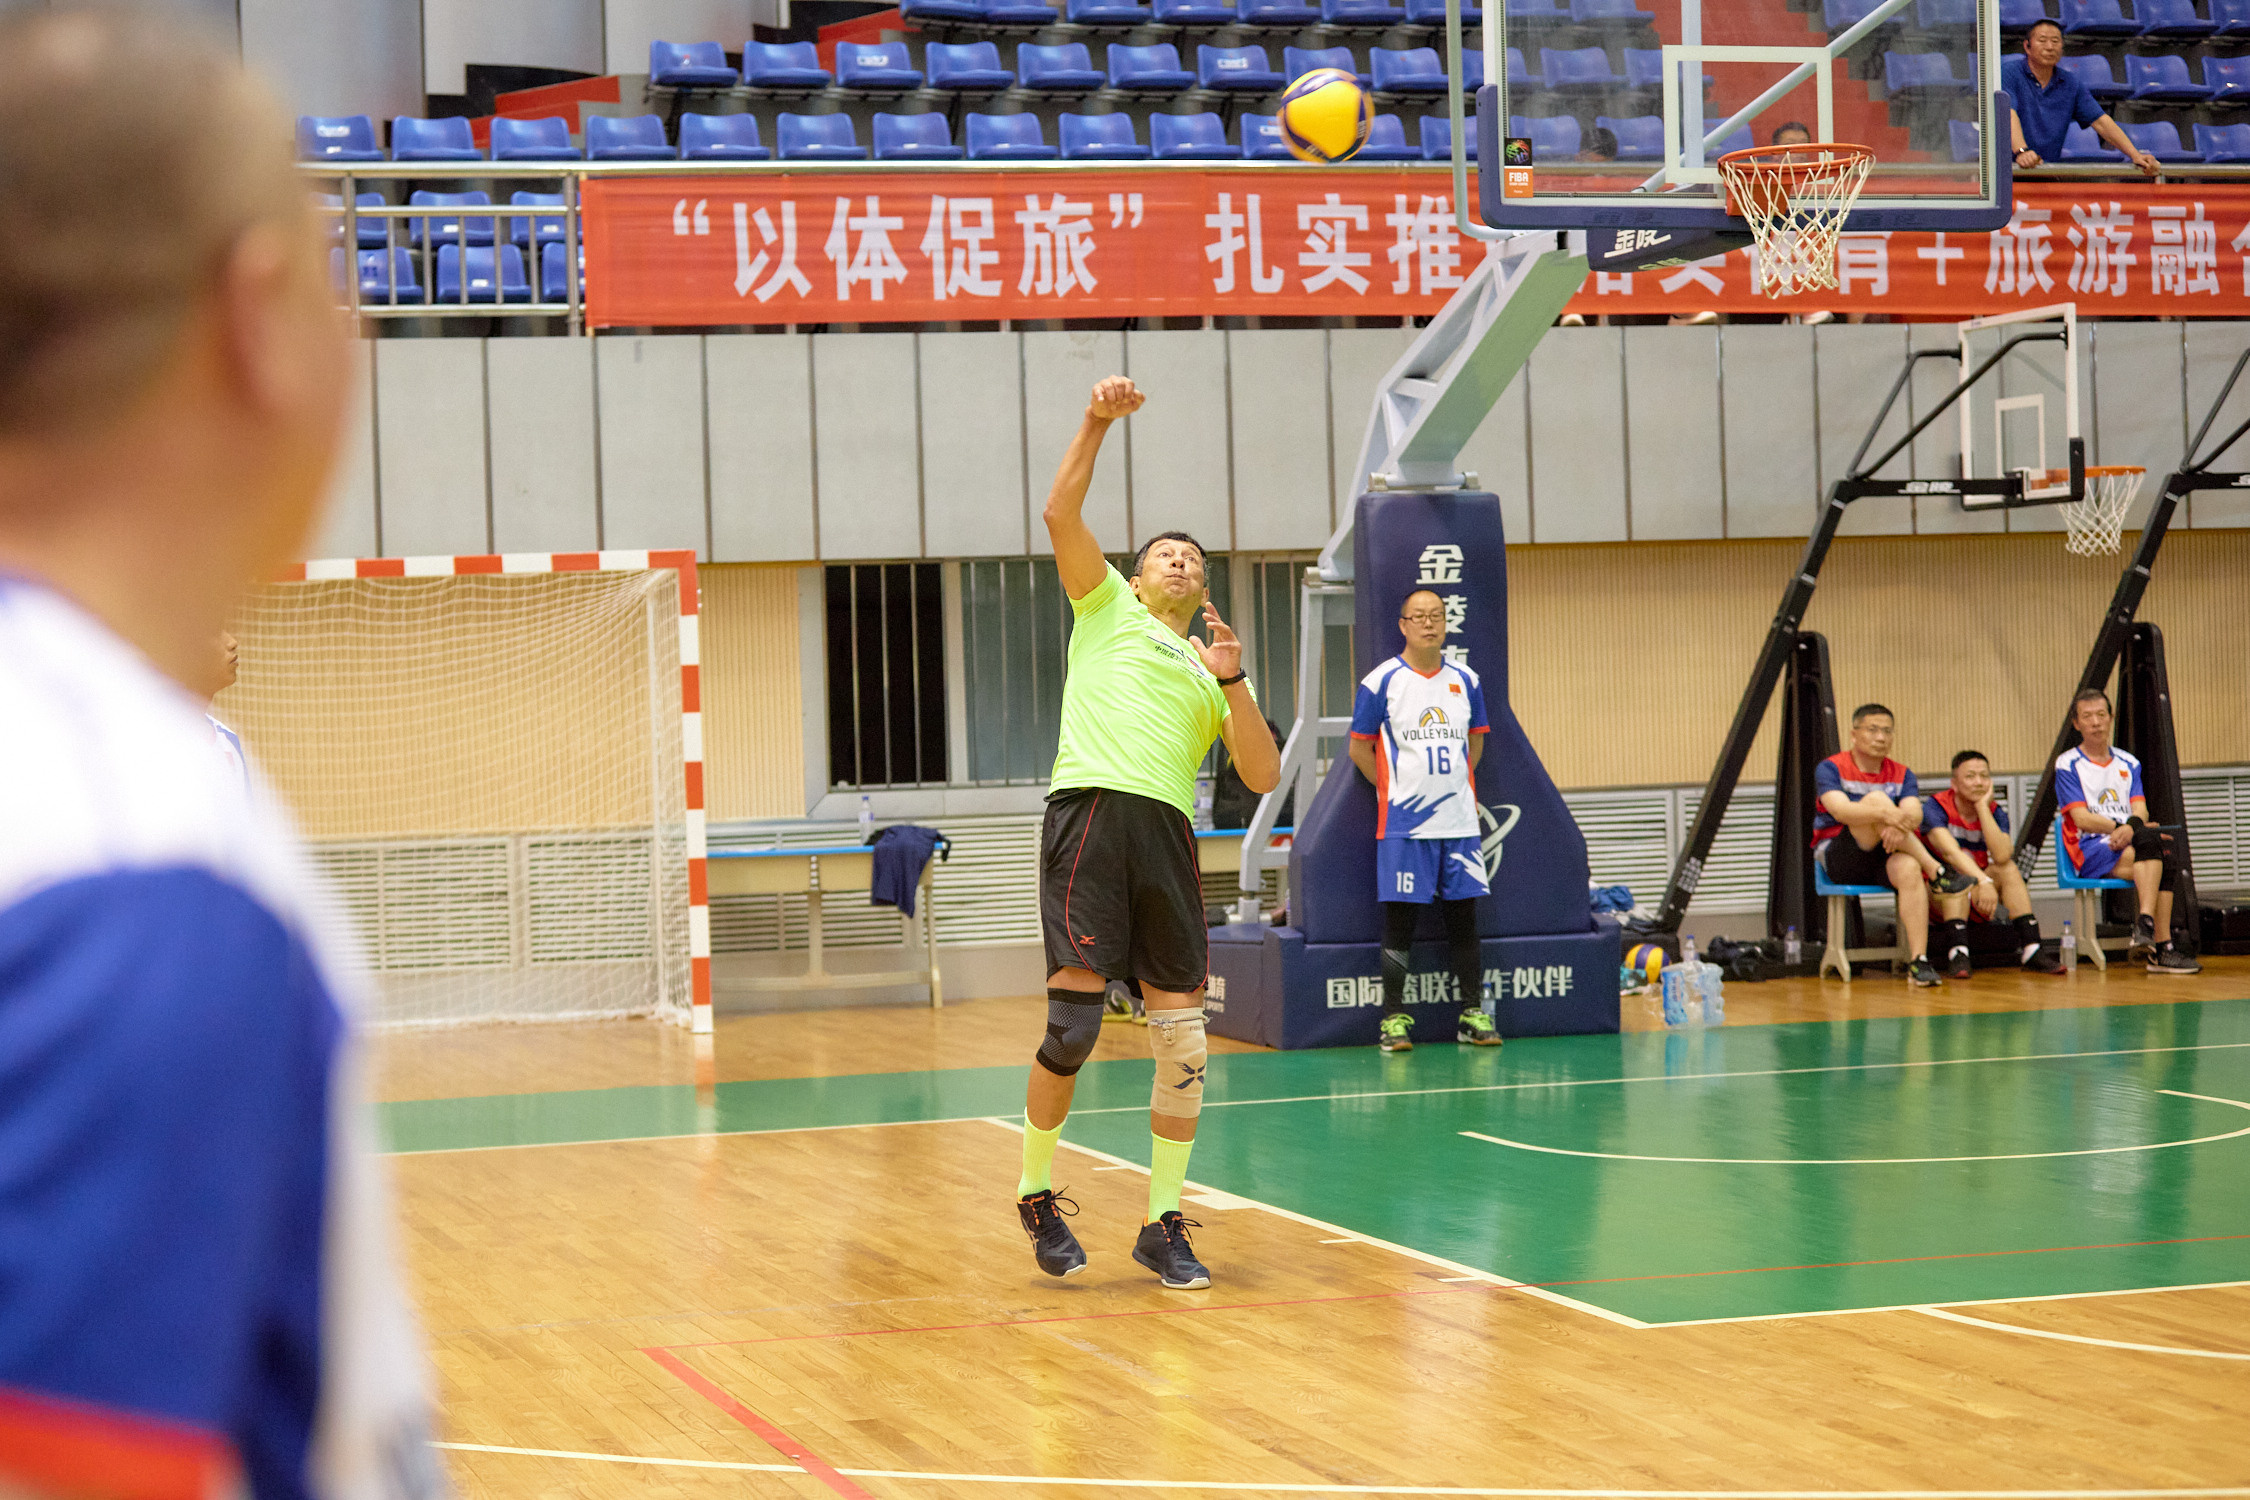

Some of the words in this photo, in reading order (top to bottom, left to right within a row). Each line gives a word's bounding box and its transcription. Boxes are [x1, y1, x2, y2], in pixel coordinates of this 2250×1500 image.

[1508, 172, 1529, 182] FIBA
[672, 192, 1144, 303] “以体促旅”
[1402, 729, 1465, 741] VOLLEYBALL
[1426, 746, 1451, 775] 16
[1396, 871, 1415, 894] 16
[1326, 966, 1574, 1009] 国际篮联作伙伴
